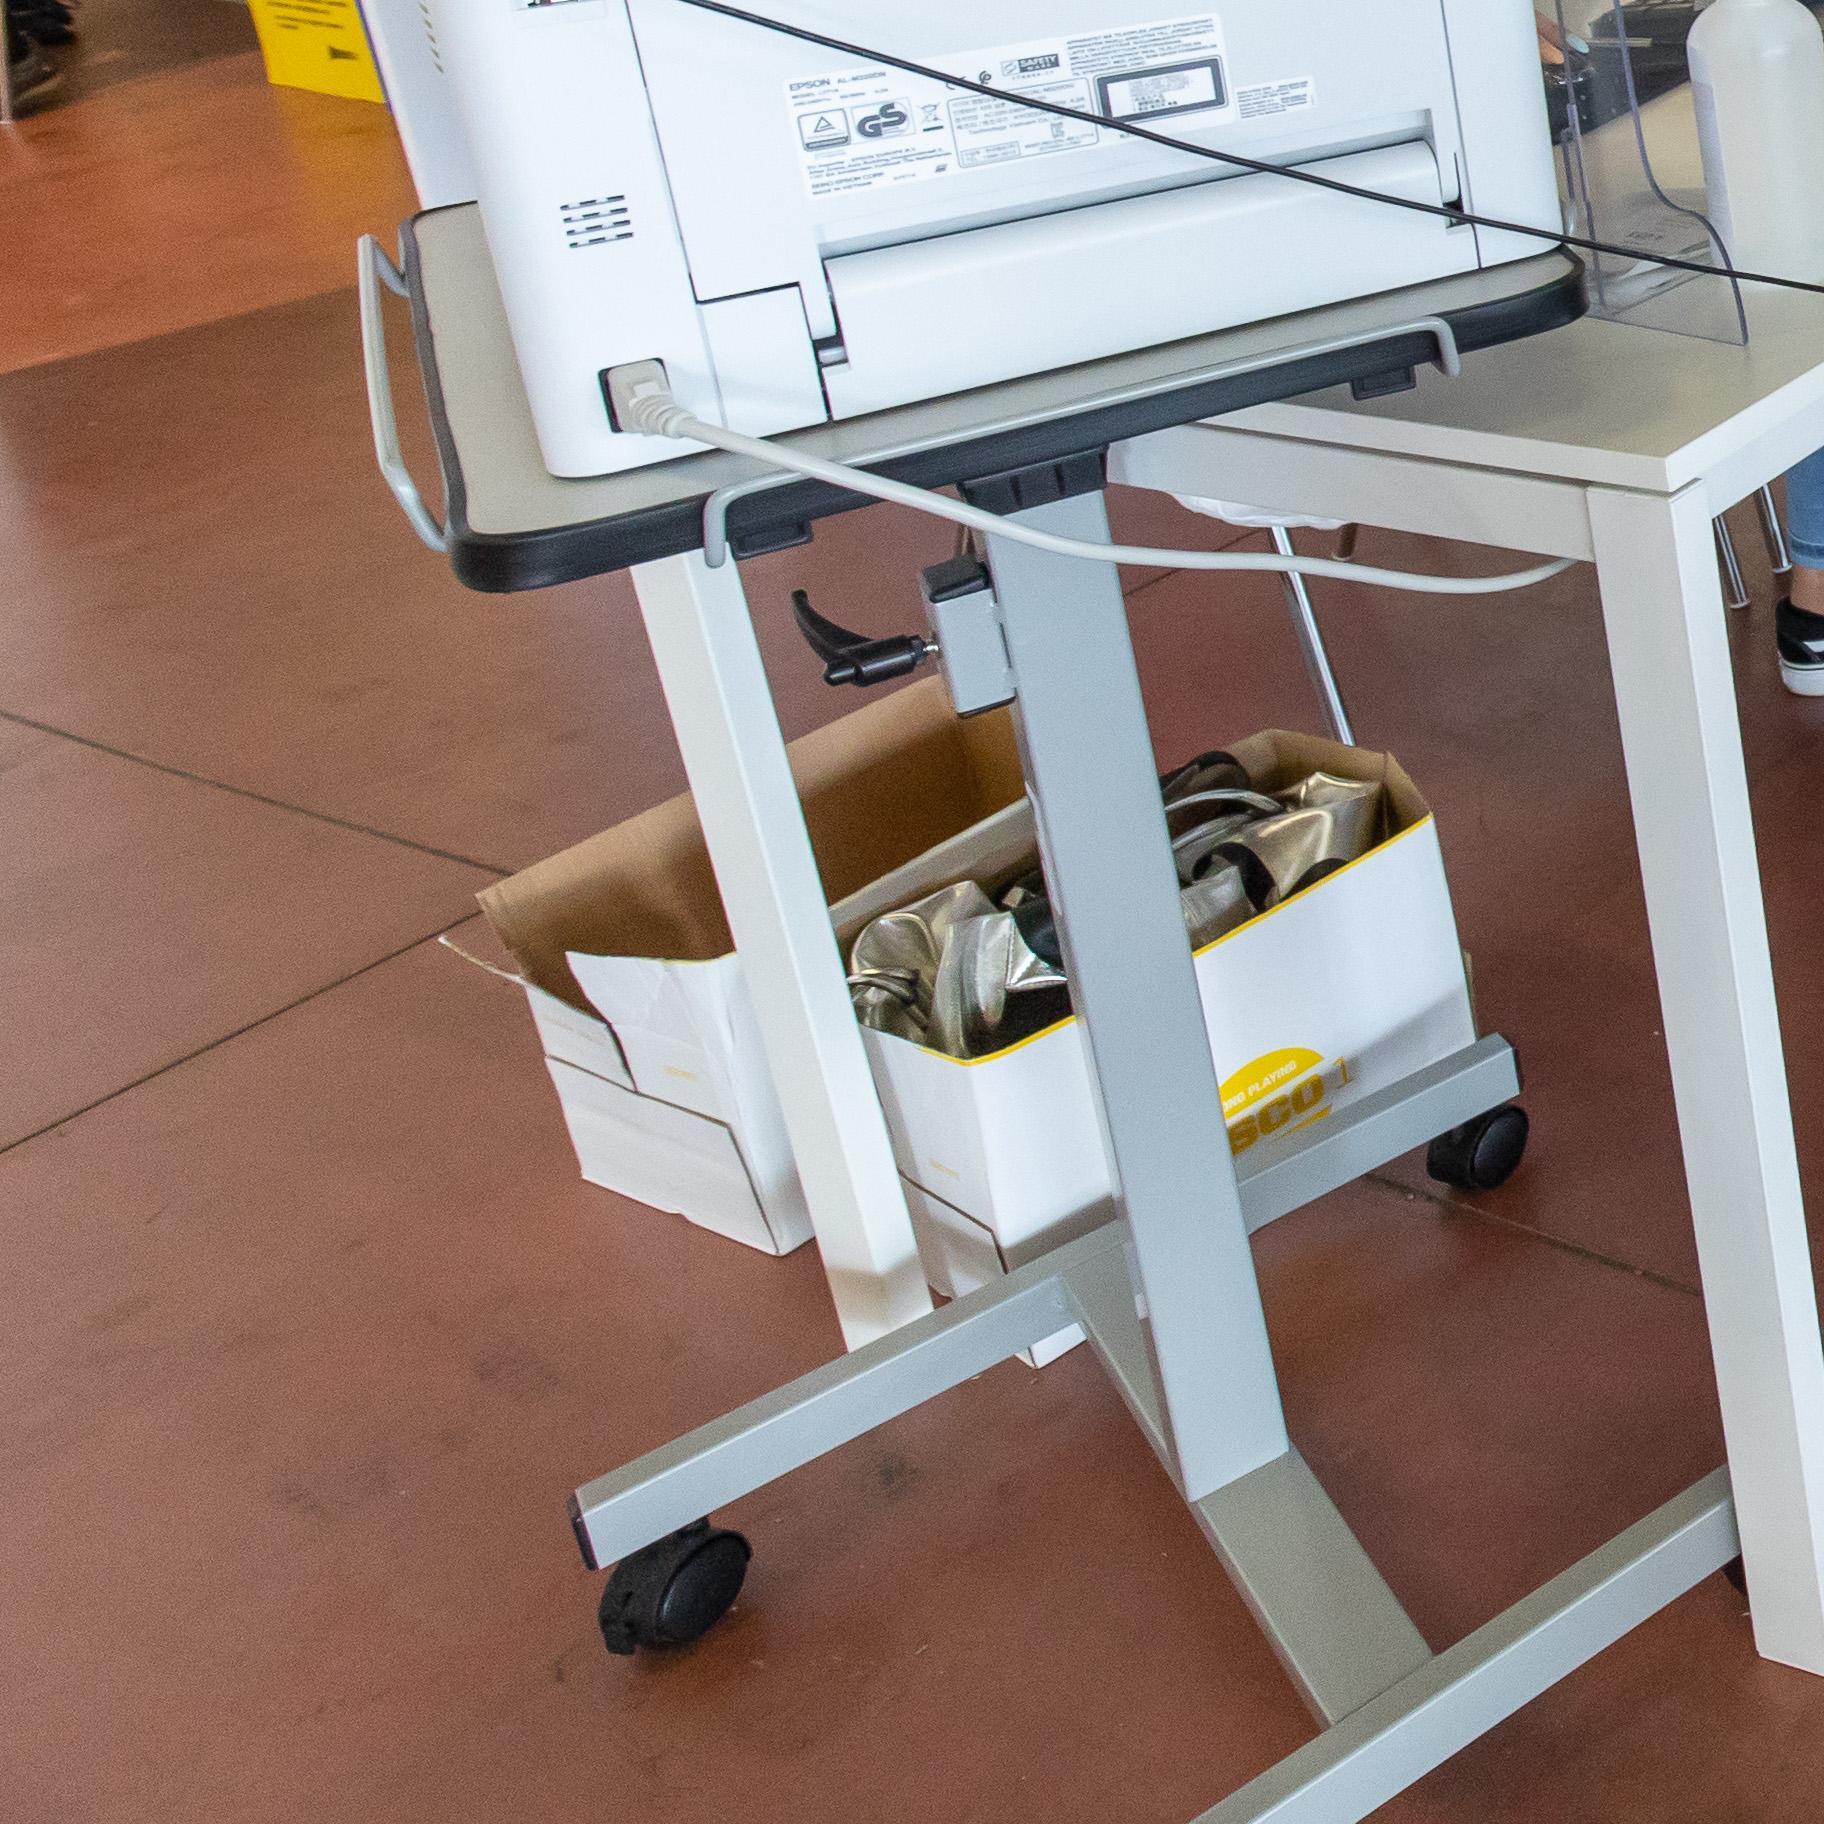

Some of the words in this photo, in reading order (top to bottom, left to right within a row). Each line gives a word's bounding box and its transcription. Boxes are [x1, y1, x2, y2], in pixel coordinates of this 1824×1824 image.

[789, 78, 831, 91] EPSON
[857, 102, 908, 138] GS
[1247, 1060, 1297, 1097] PLAYING
